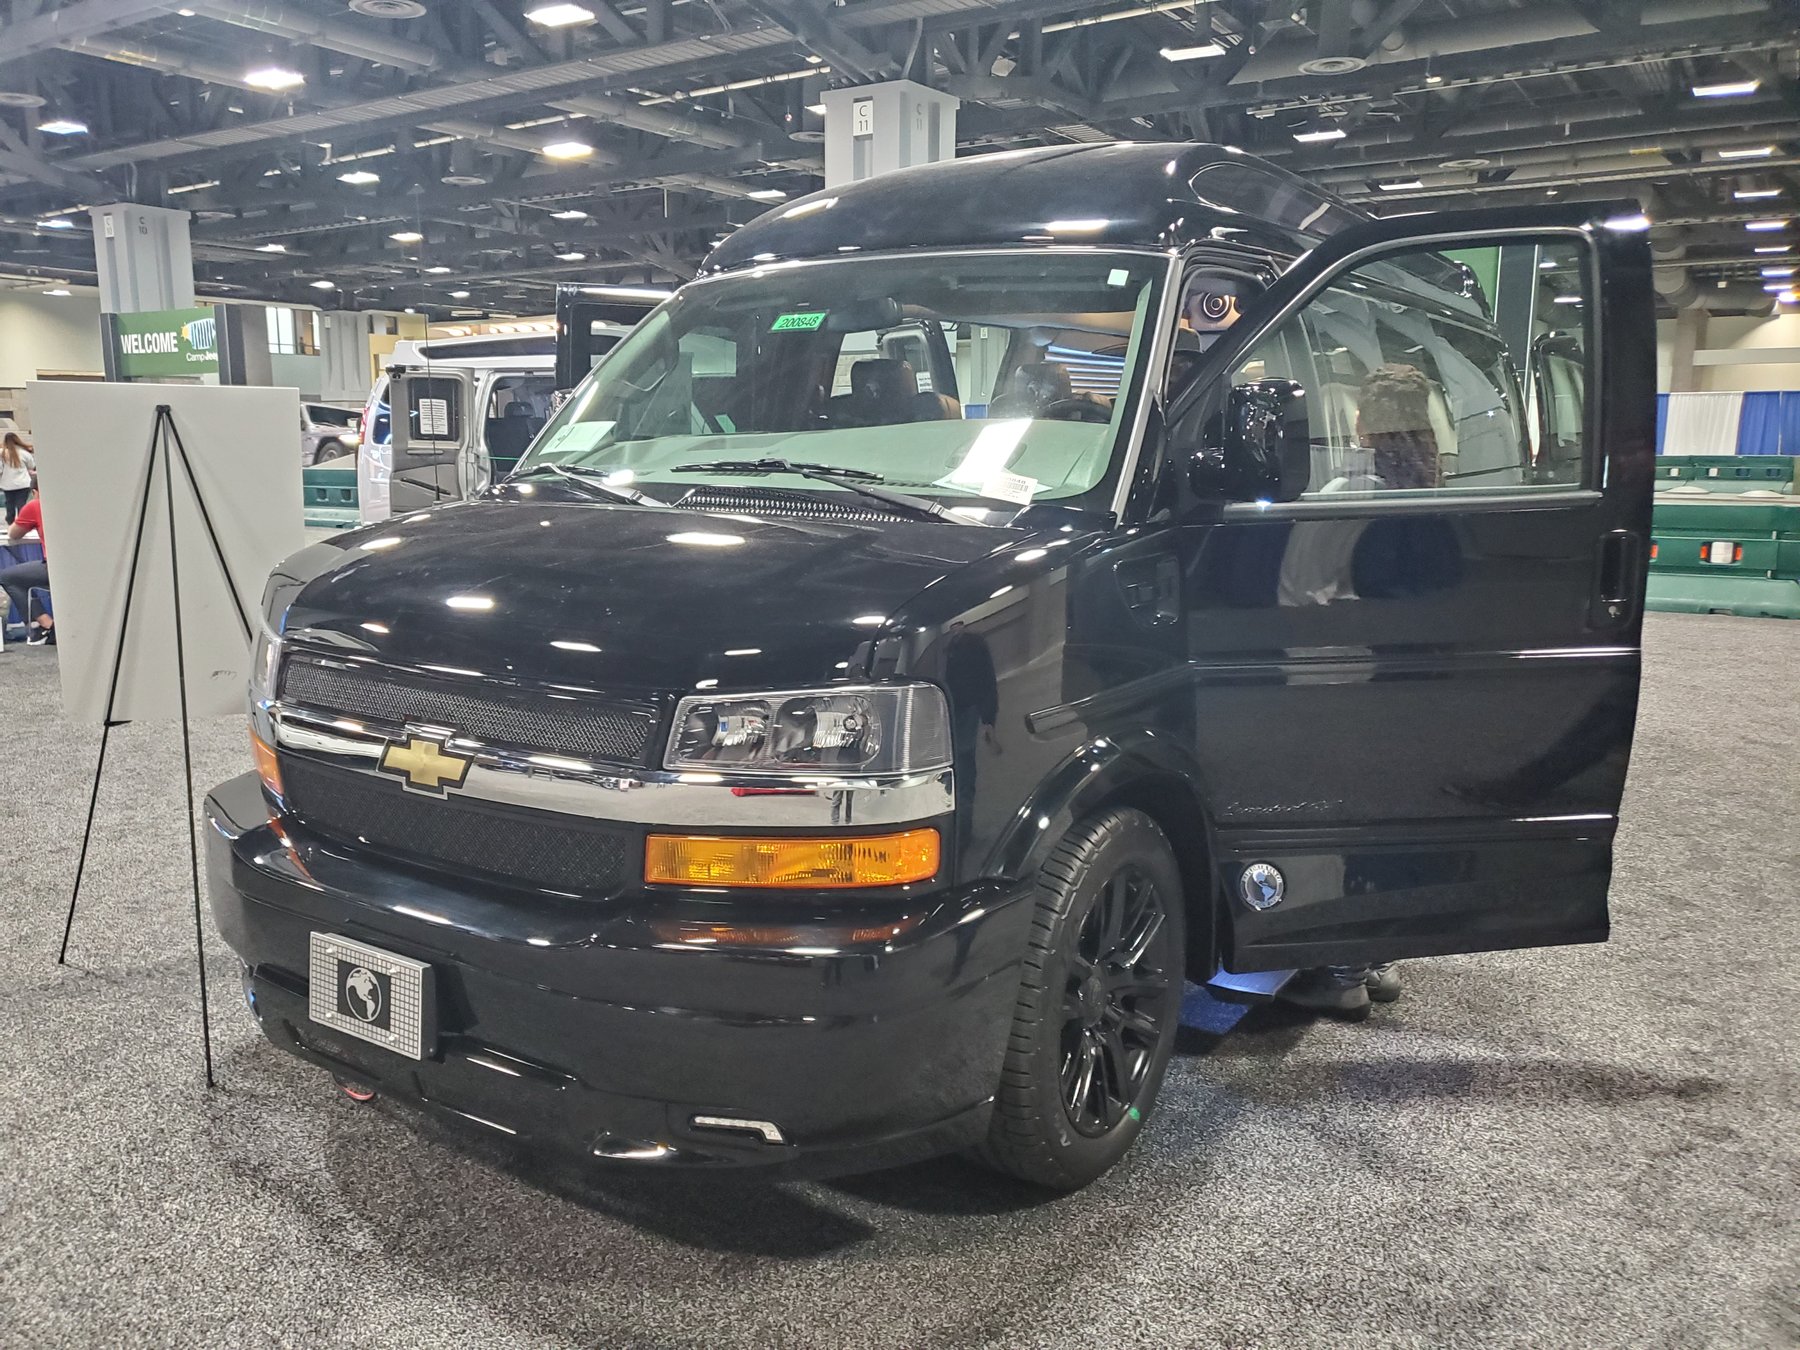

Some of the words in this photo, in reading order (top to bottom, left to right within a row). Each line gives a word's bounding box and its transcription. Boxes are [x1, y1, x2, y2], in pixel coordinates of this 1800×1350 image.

[859, 104, 868, 117] C
[859, 119, 868, 132] 11
[139, 216, 145, 225] C
[777, 316, 819, 329] 200848
[120, 331, 179, 354] WELCOME
